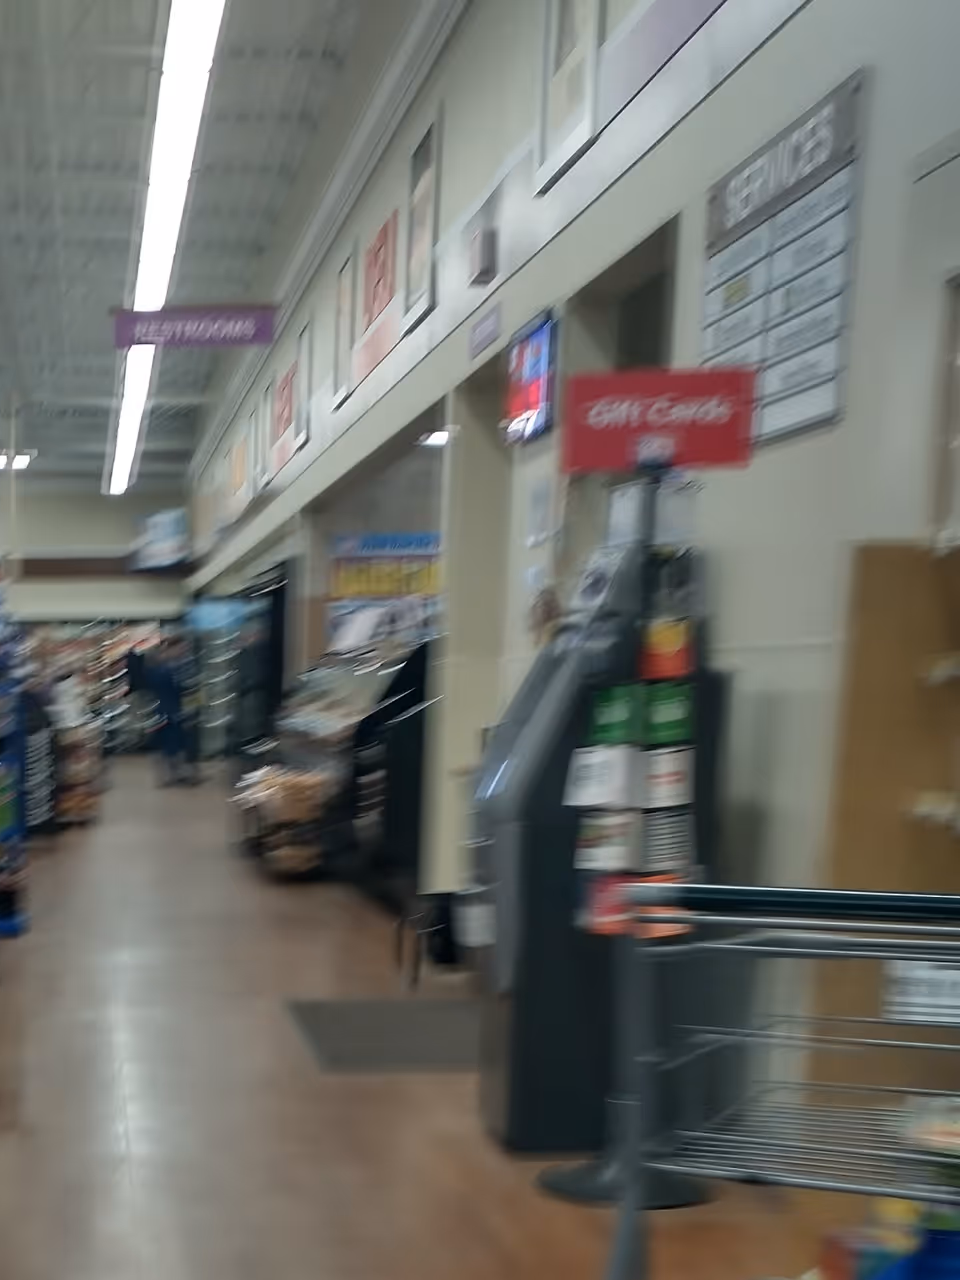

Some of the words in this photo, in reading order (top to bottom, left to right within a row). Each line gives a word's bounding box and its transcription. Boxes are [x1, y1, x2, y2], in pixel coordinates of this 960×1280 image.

[134, 317, 257, 341] RESTROOMS
[587, 396, 641, 429] Gift
[646, 394, 733, 426] Cards
